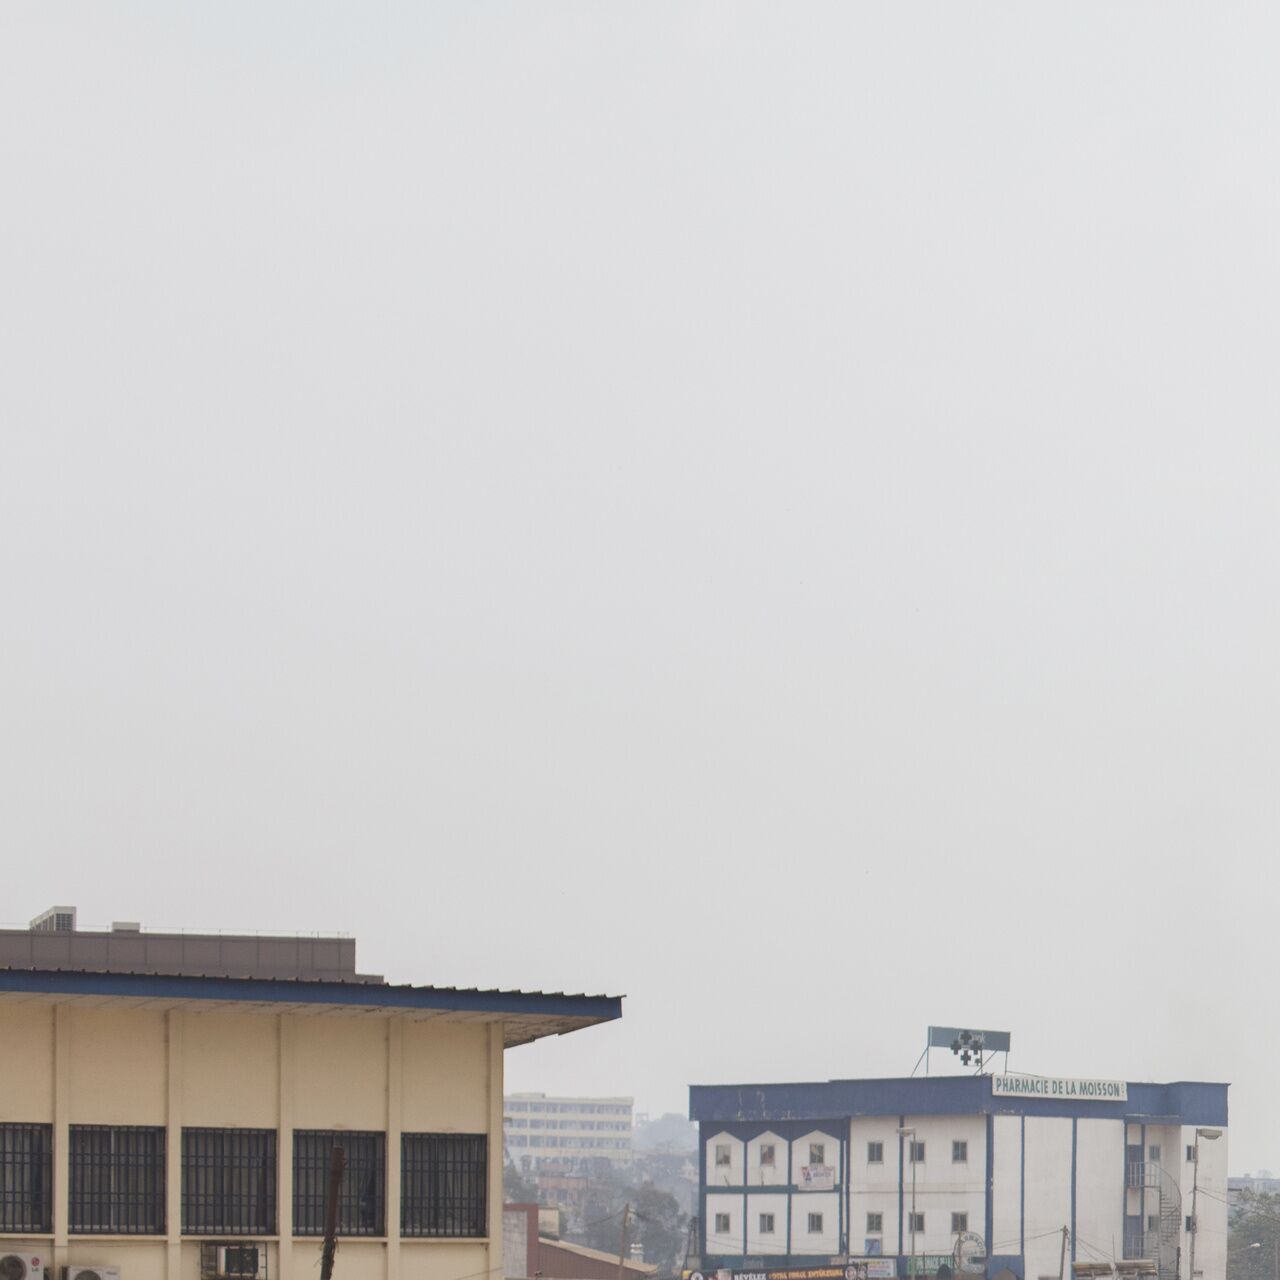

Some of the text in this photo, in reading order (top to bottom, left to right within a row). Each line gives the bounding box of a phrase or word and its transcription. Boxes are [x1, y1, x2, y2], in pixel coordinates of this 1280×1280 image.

[996, 1078, 1048, 1094] PHARMACIE
[1052, 1080, 1063, 1094] DE
[1065, 1081, 1076, 1095] LA
[1079, 1082, 1120, 1097] MOISSON
